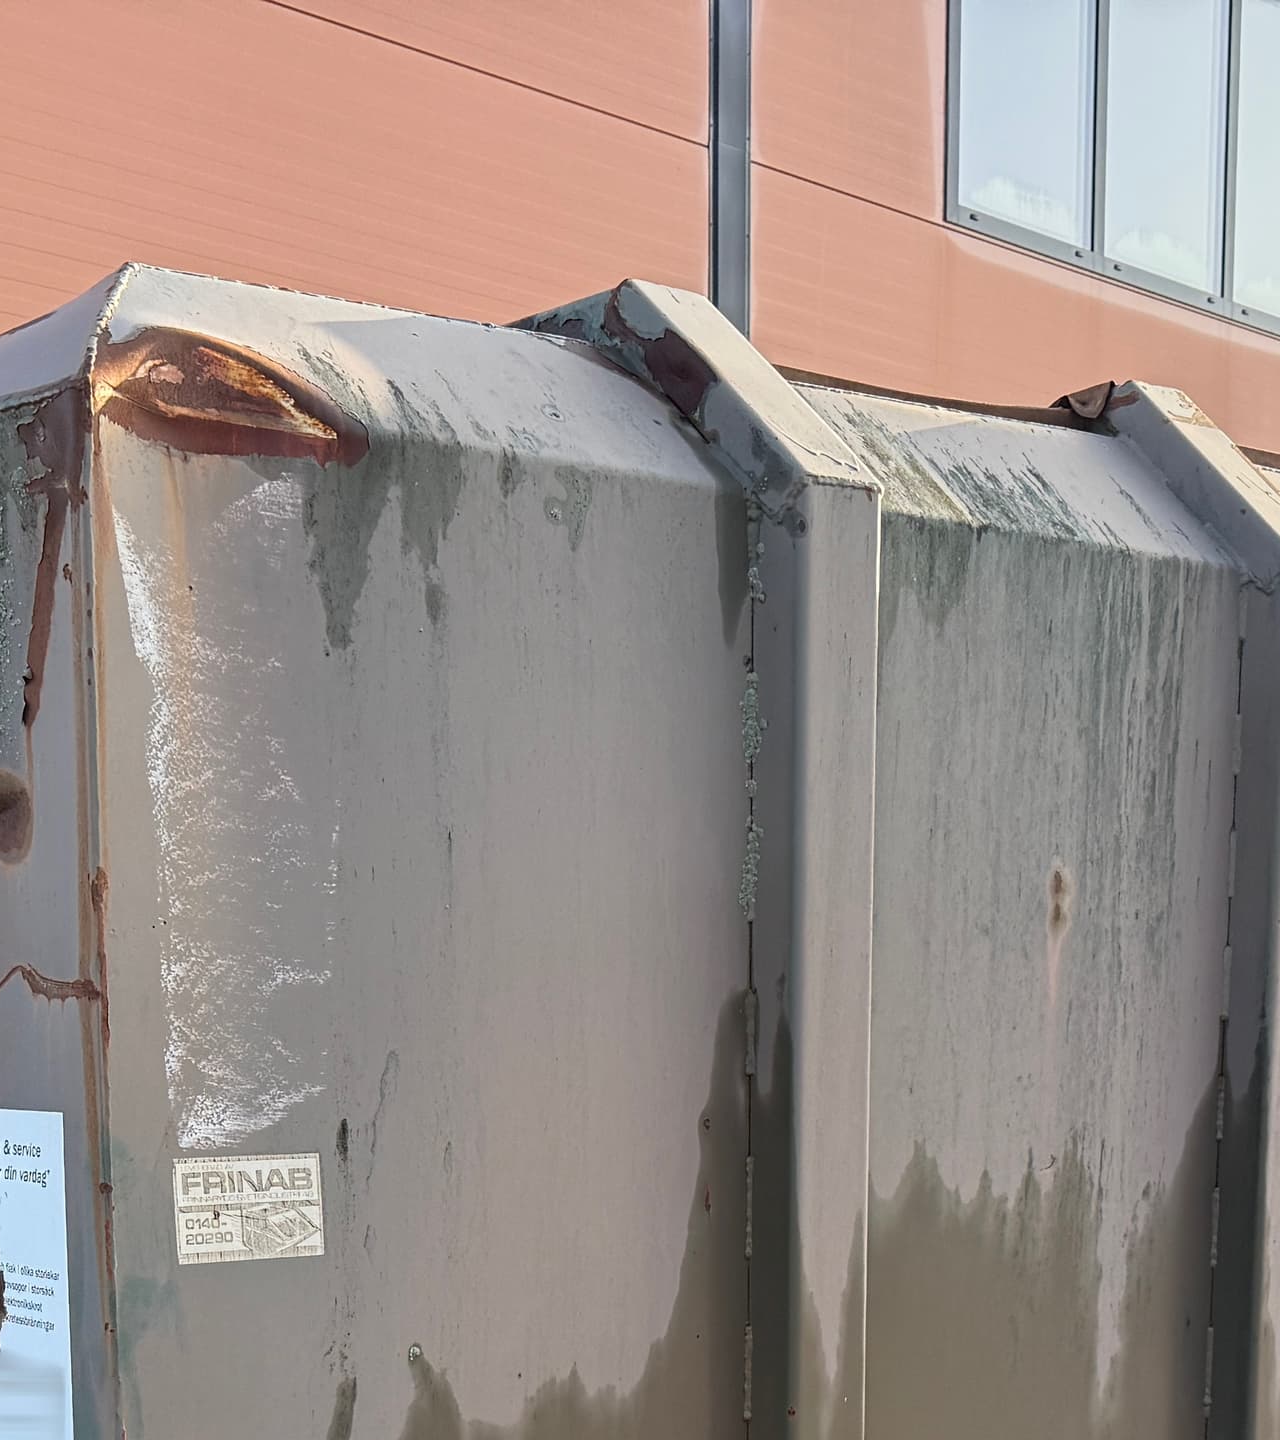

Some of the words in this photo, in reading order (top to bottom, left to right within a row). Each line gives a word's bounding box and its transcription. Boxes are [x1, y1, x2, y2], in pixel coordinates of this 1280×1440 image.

[4, 1139, 11, 1155] &
[12, 1142, 41, 1158] service
[4, 1165, 17, 1180] din
[181, 1168, 313, 1196] FRINAB
[185, 1230, 234, 1246] 20290
